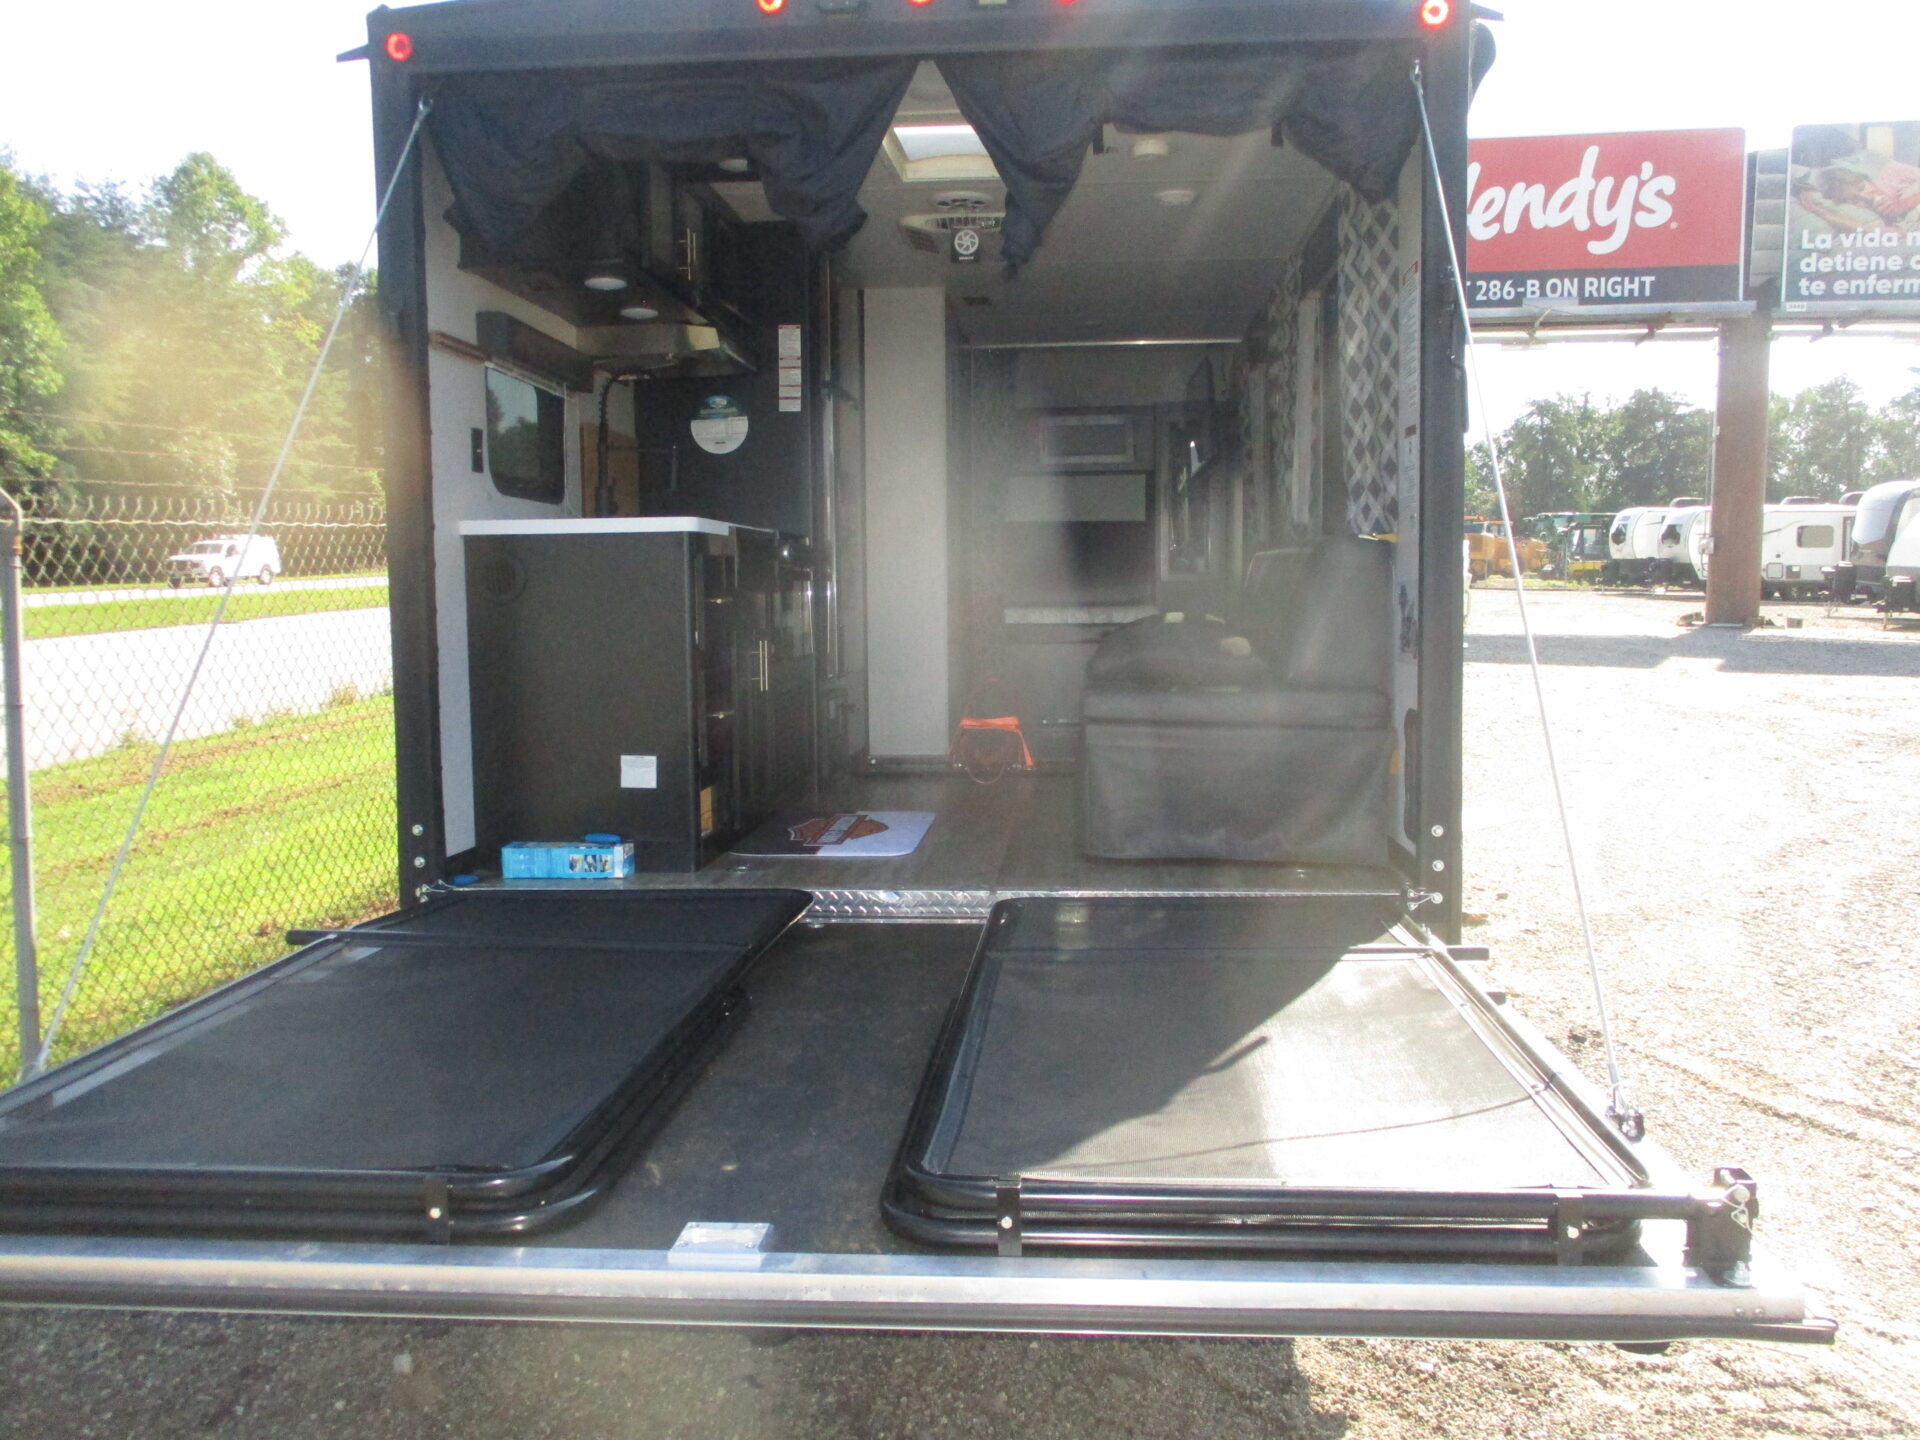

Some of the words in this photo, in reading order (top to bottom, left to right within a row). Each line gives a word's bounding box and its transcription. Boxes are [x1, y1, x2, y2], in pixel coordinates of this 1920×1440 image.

[1802, 229, 1832, 249] La
[1841, 227, 1898, 248] vida
[1800, 251, 1903, 272] detiene
[1475, 279, 1540, 300] 286-B
[1545, 277, 1579, 298] ON
[1584, 276, 1656, 297] RIGHT
[1799, 278, 1826, 296] te
